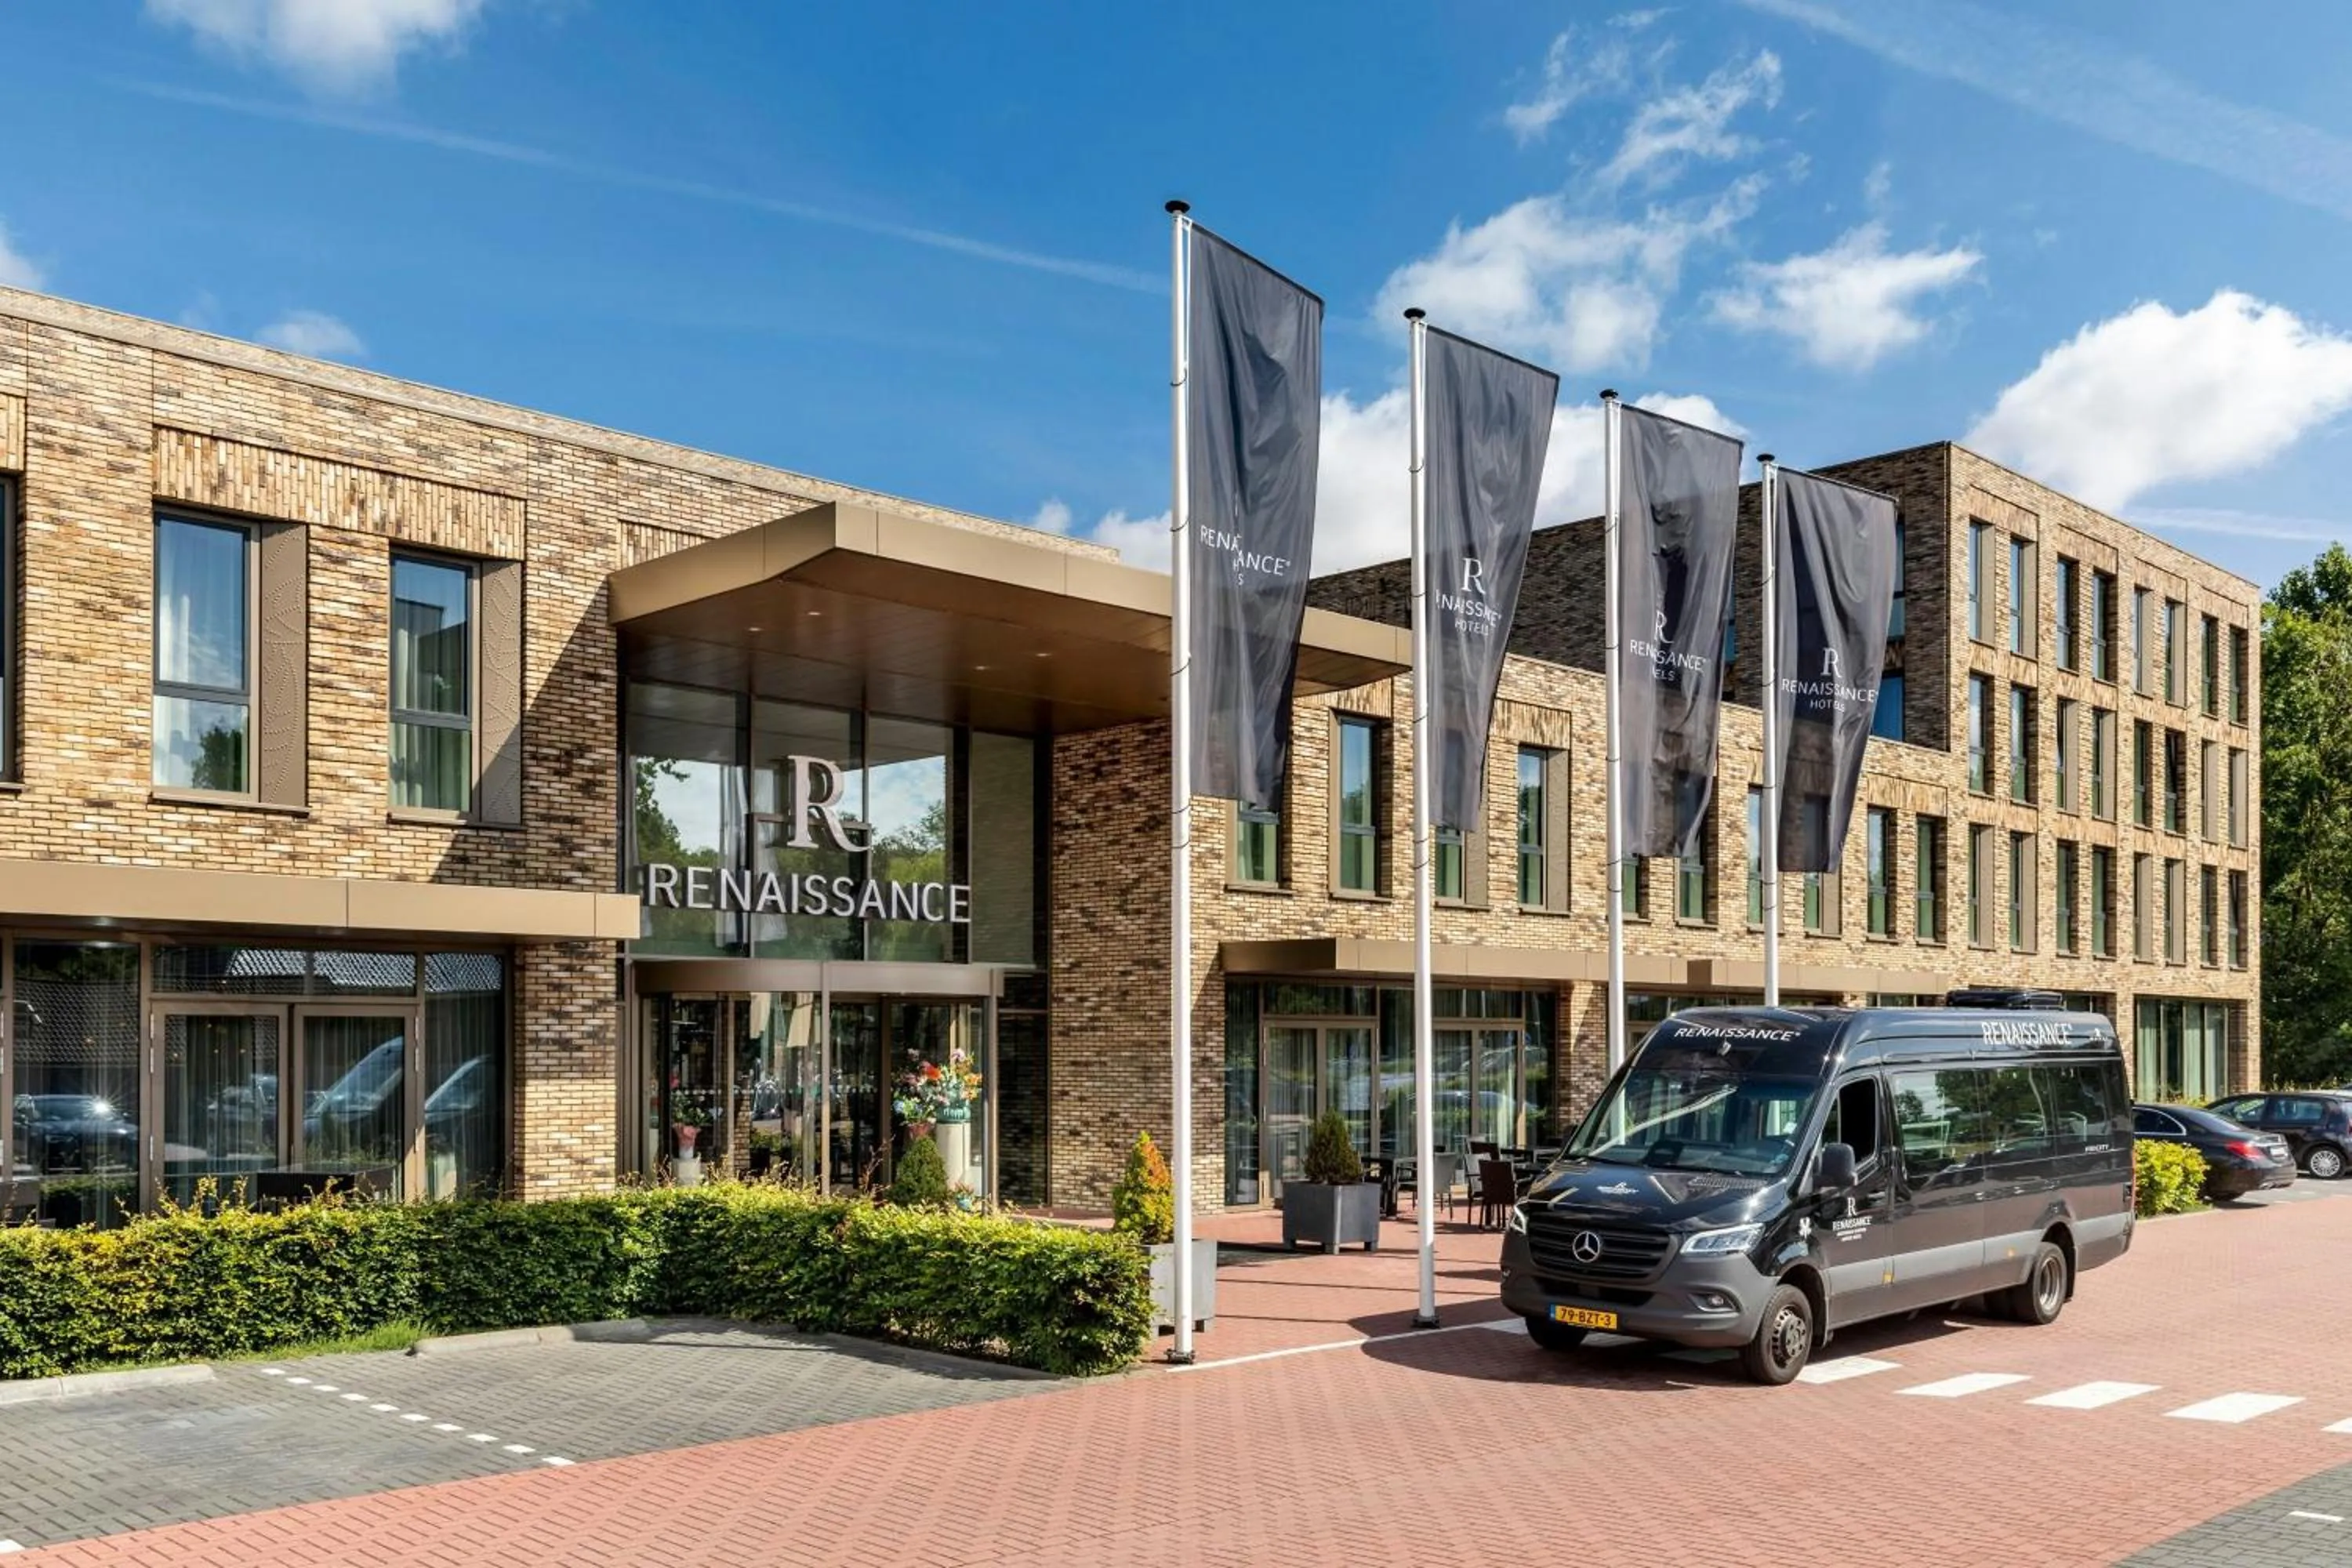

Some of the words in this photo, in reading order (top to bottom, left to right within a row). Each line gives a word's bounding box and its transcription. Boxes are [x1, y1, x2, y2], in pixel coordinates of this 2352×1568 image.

[1461, 557, 1486, 595] R
[1820, 647, 1842, 678] R
[786, 755, 872, 852] R
[648, 863, 971, 923] RENAISSANCE
[1674, 1027, 1795, 1042] RENAISSANCE
[1981, 1021, 2072, 1045] RENAISSANCE
[1847, 1196, 1857, 1217] R
[1561, 1307, 1612, 1326] 79-BZT-3
